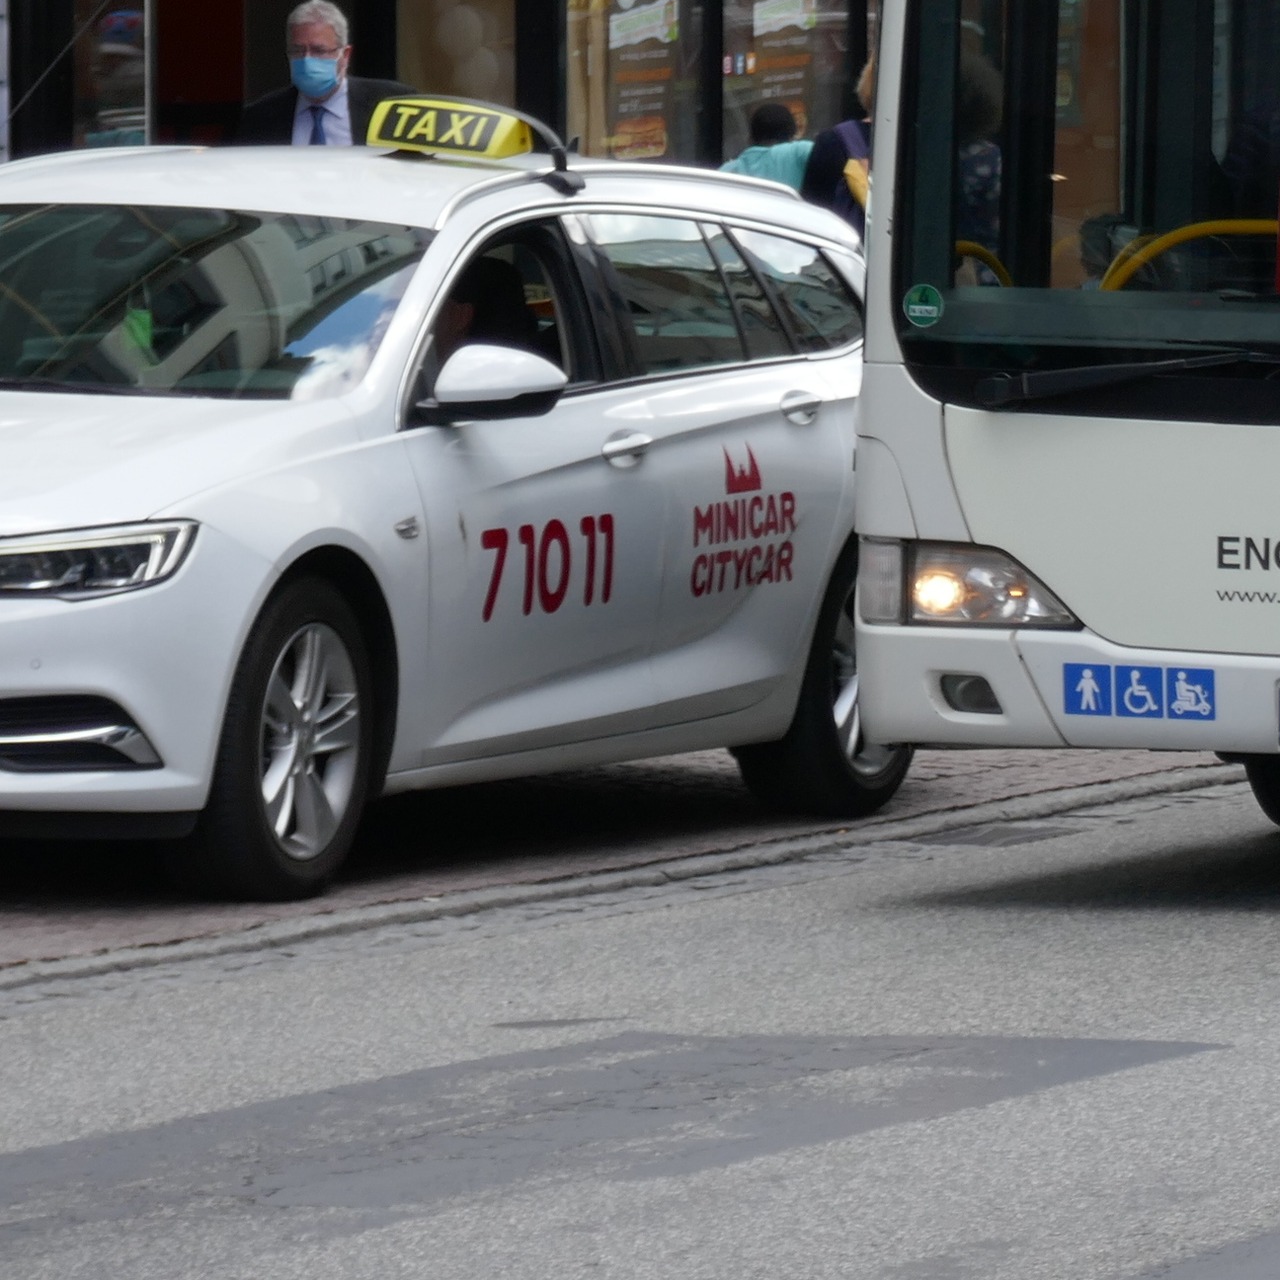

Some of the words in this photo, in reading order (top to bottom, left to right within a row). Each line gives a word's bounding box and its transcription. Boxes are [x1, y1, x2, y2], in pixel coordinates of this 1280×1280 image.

[392, 105, 489, 148] TAXI
[693, 491, 797, 548] MINICAR
[690, 541, 793, 598] CITYCAR
